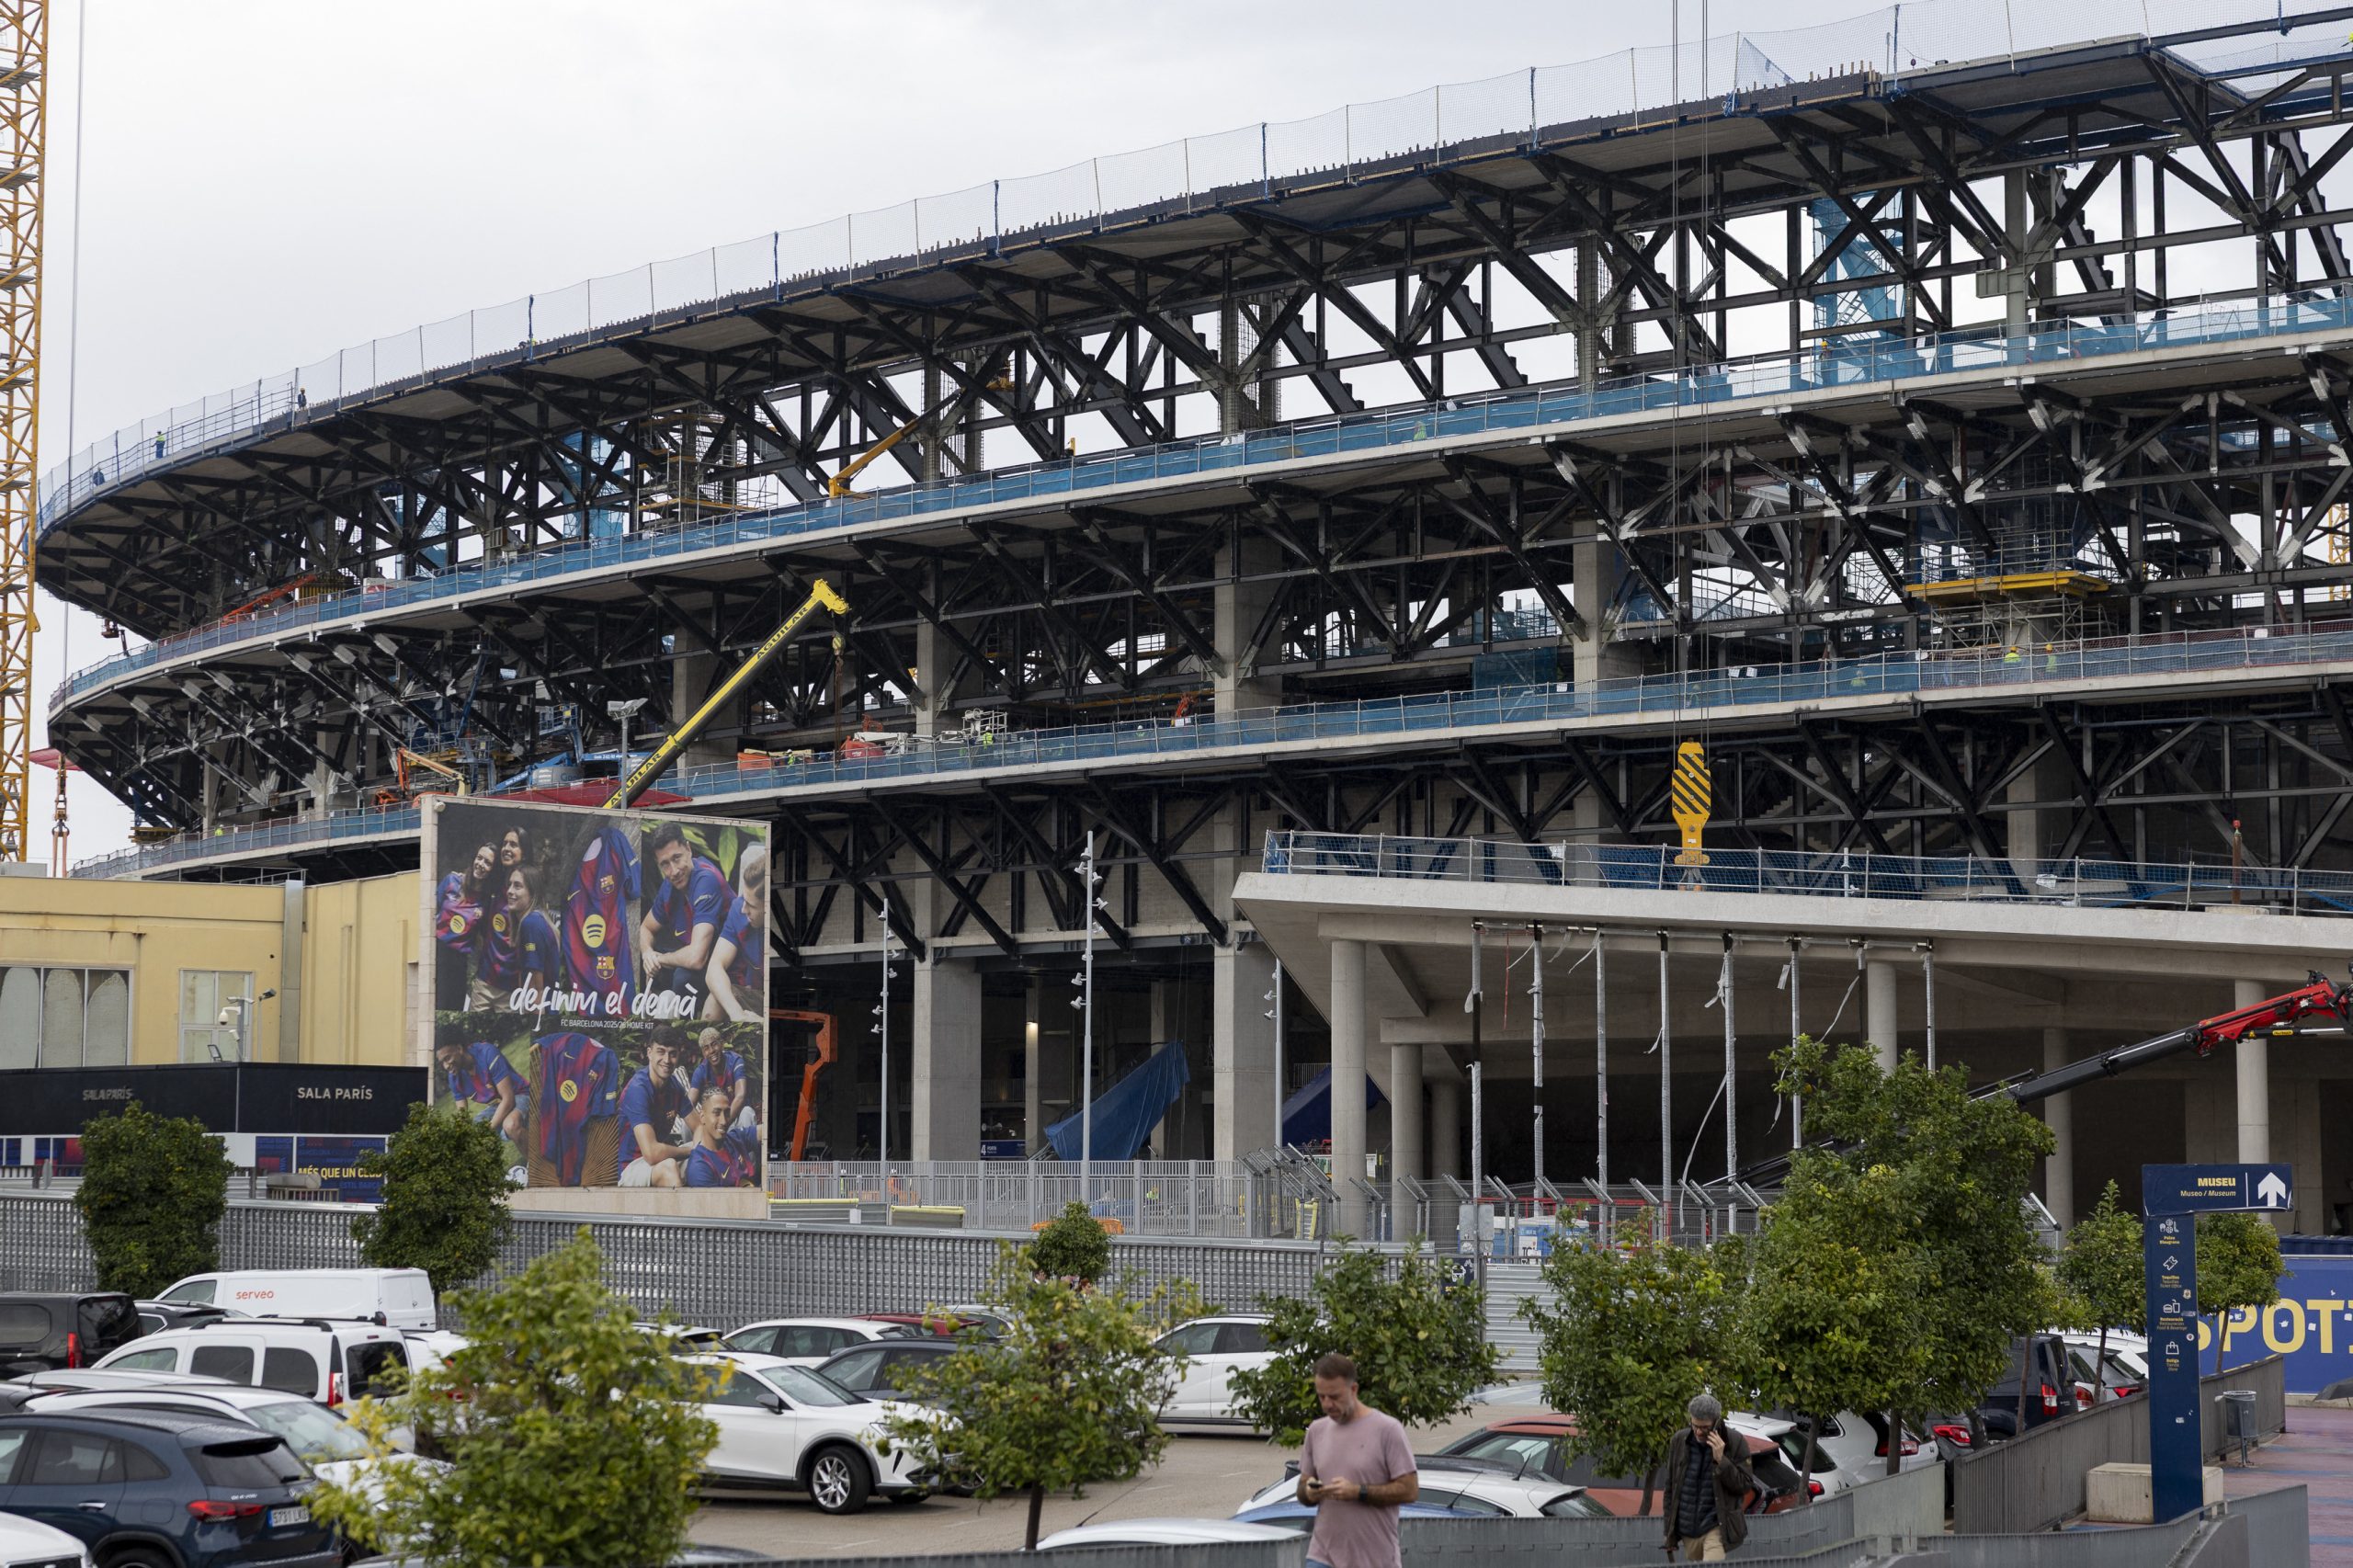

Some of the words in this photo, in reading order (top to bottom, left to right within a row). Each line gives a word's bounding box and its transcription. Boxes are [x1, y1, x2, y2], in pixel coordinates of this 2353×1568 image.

[757, 608, 808, 659] AGUILAR
[509, 971, 597, 1032] definim
[605, 981, 628, 1015] el
[631, 978, 699, 1020] demà
[569, 1019, 603, 1028] BARCELONA
[298, 1087, 331, 1099] SALA
[335, 1085, 373, 1100] PARÍS
[321, 1167, 340, 1180] QUE
[342, 1168, 356, 1178] UN
[2198, 1177, 2236, 1187] MUSEU
[235, 1290, 274, 1300] serveo
